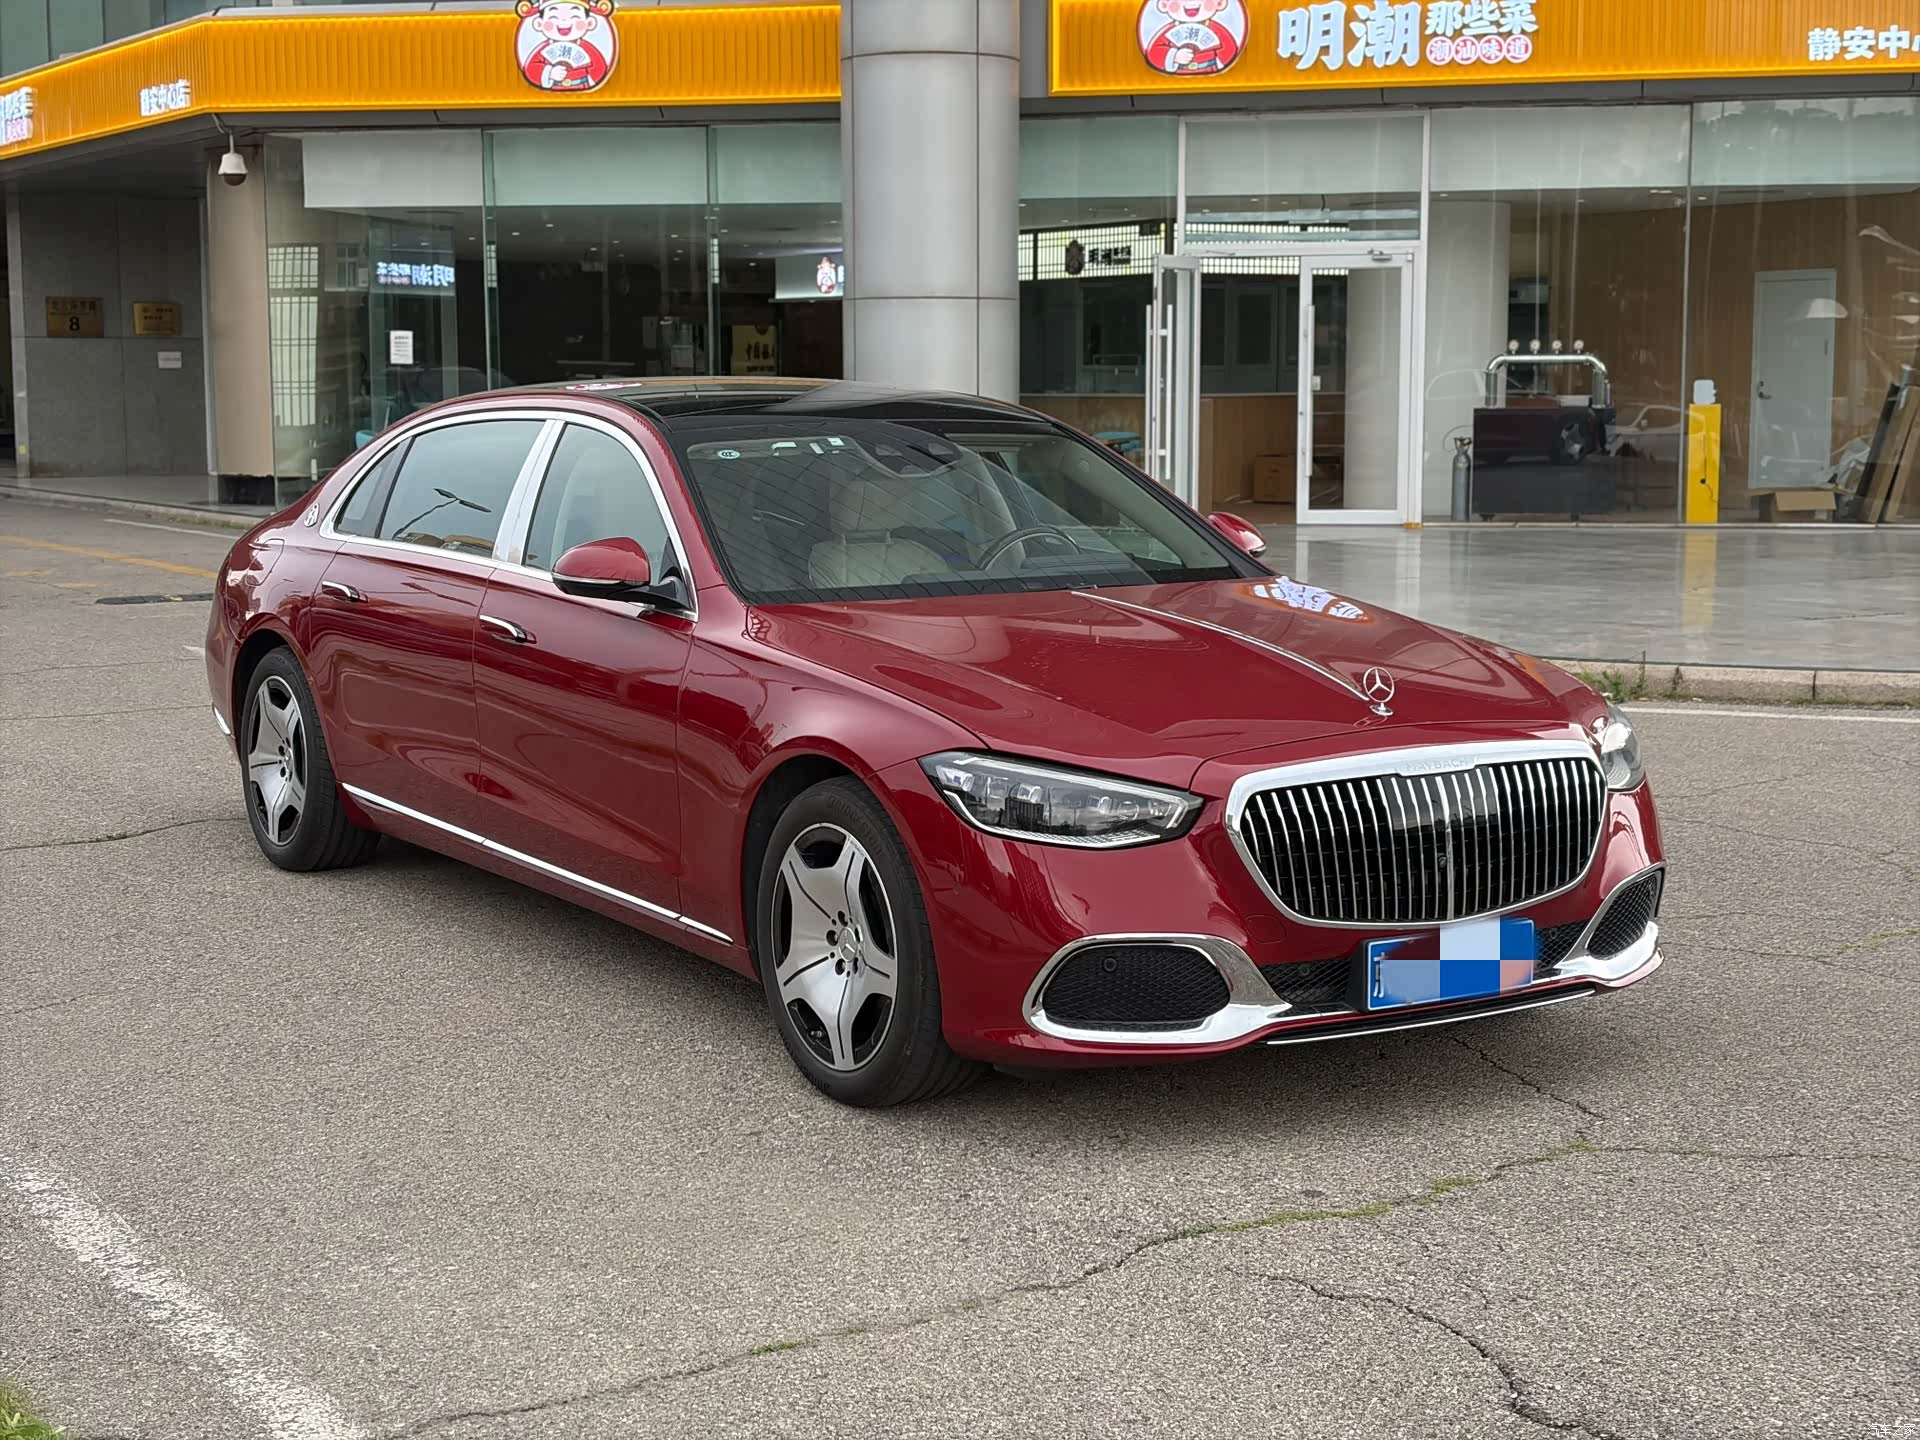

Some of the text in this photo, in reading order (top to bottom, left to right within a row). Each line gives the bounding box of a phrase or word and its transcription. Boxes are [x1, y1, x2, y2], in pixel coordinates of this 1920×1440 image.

[1278, 0, 1539, 70] 明潮 那些菜
[1427, 36, 1531, 64] 潮汕味道
[1808, 25, 1920, 61] 静安中
[69, 316, 80, 331] 8
